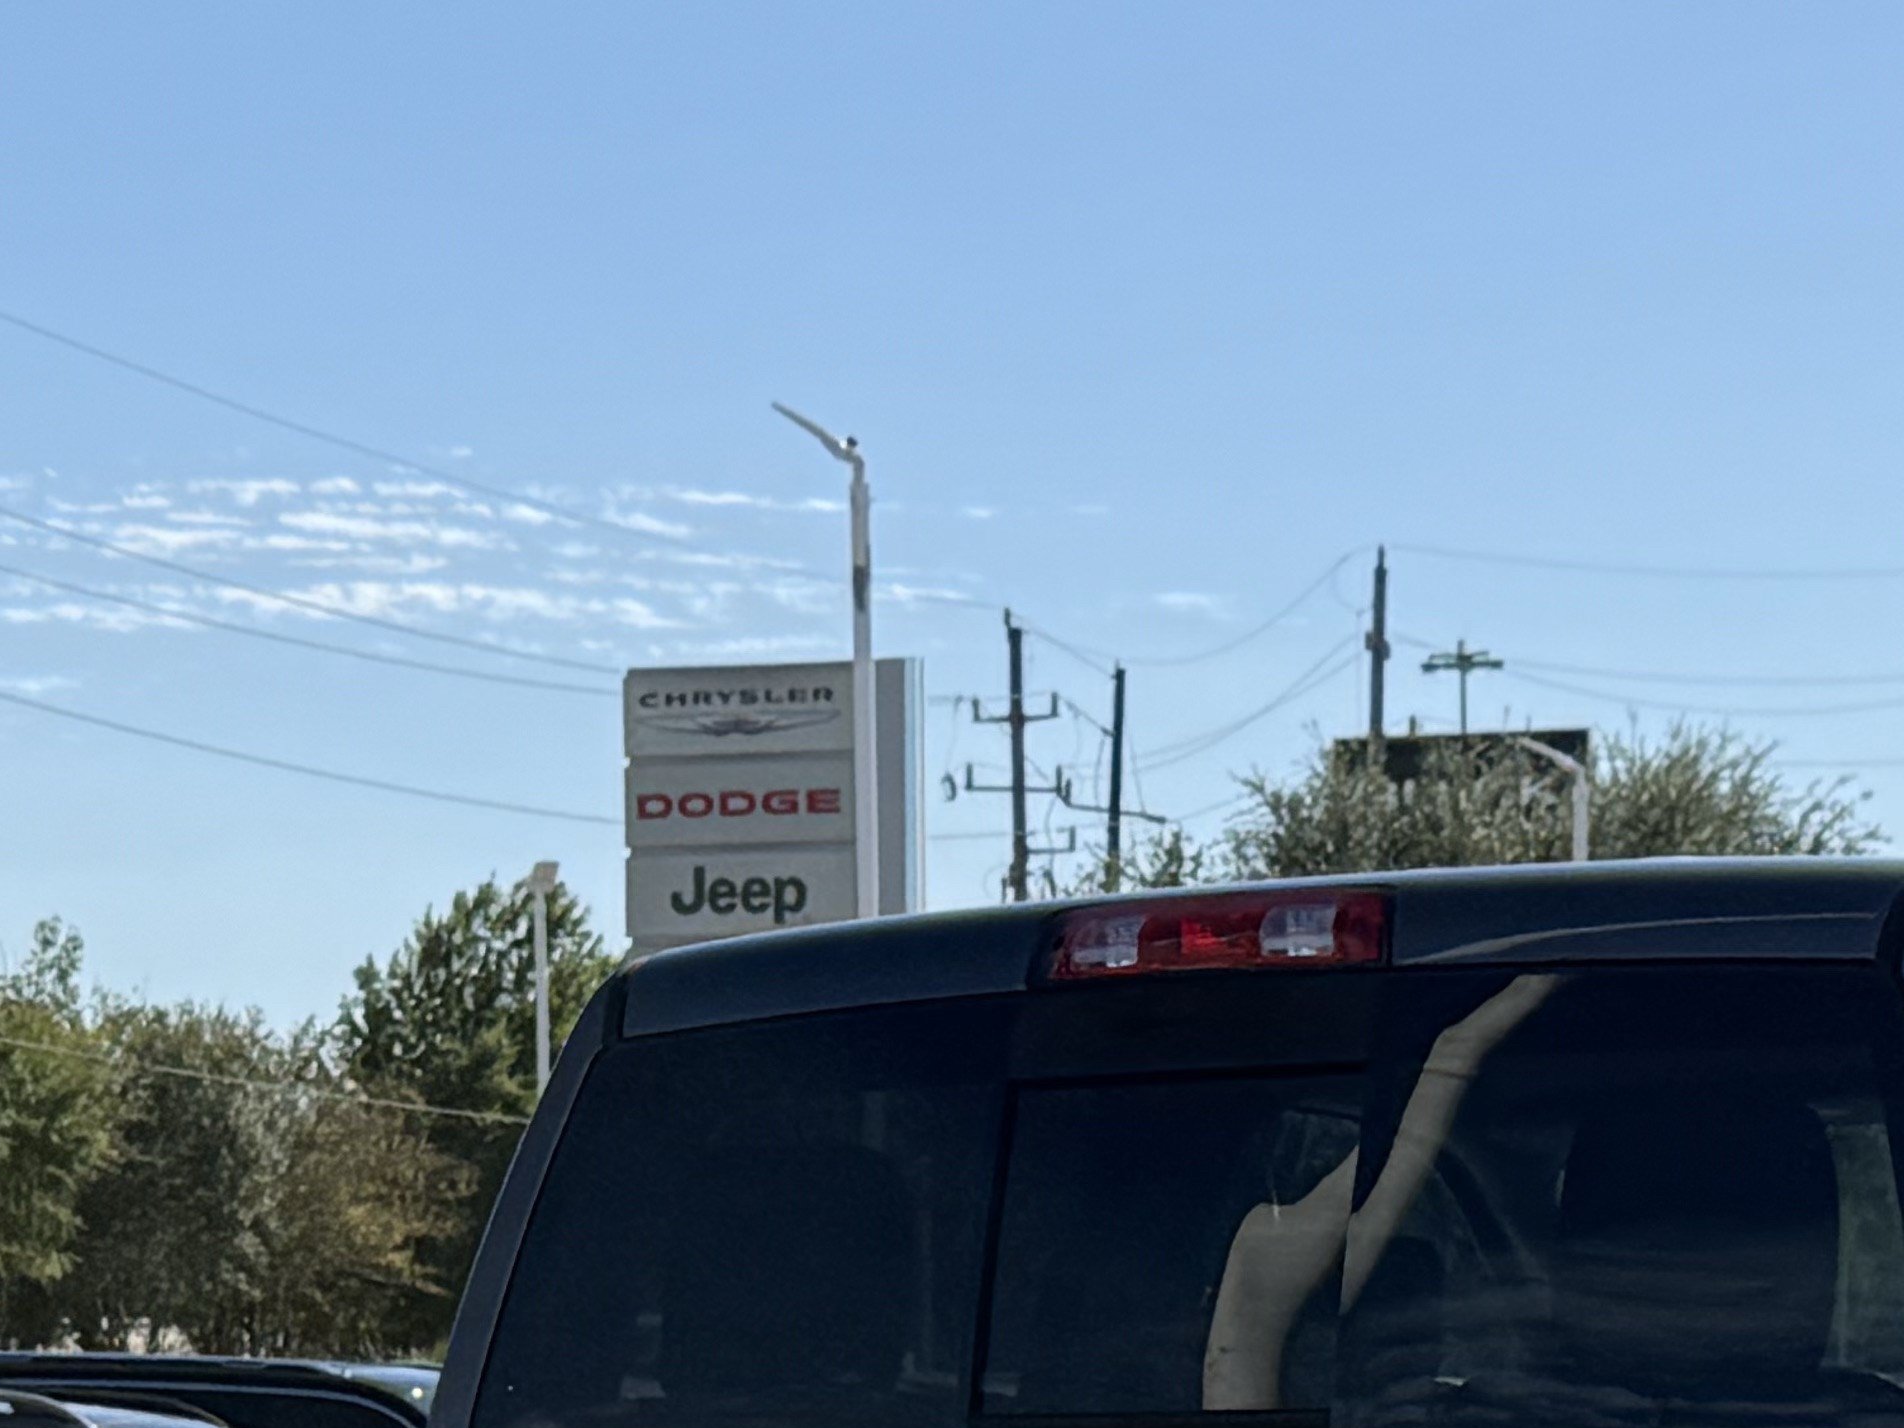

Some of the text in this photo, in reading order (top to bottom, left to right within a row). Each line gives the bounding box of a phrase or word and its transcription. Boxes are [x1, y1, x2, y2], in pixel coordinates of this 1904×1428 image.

[638, 686, 834, 709] CHRYSLER
[636, 787, 842, 820] DODGE
[670, 865, 808, 924] Jeep
